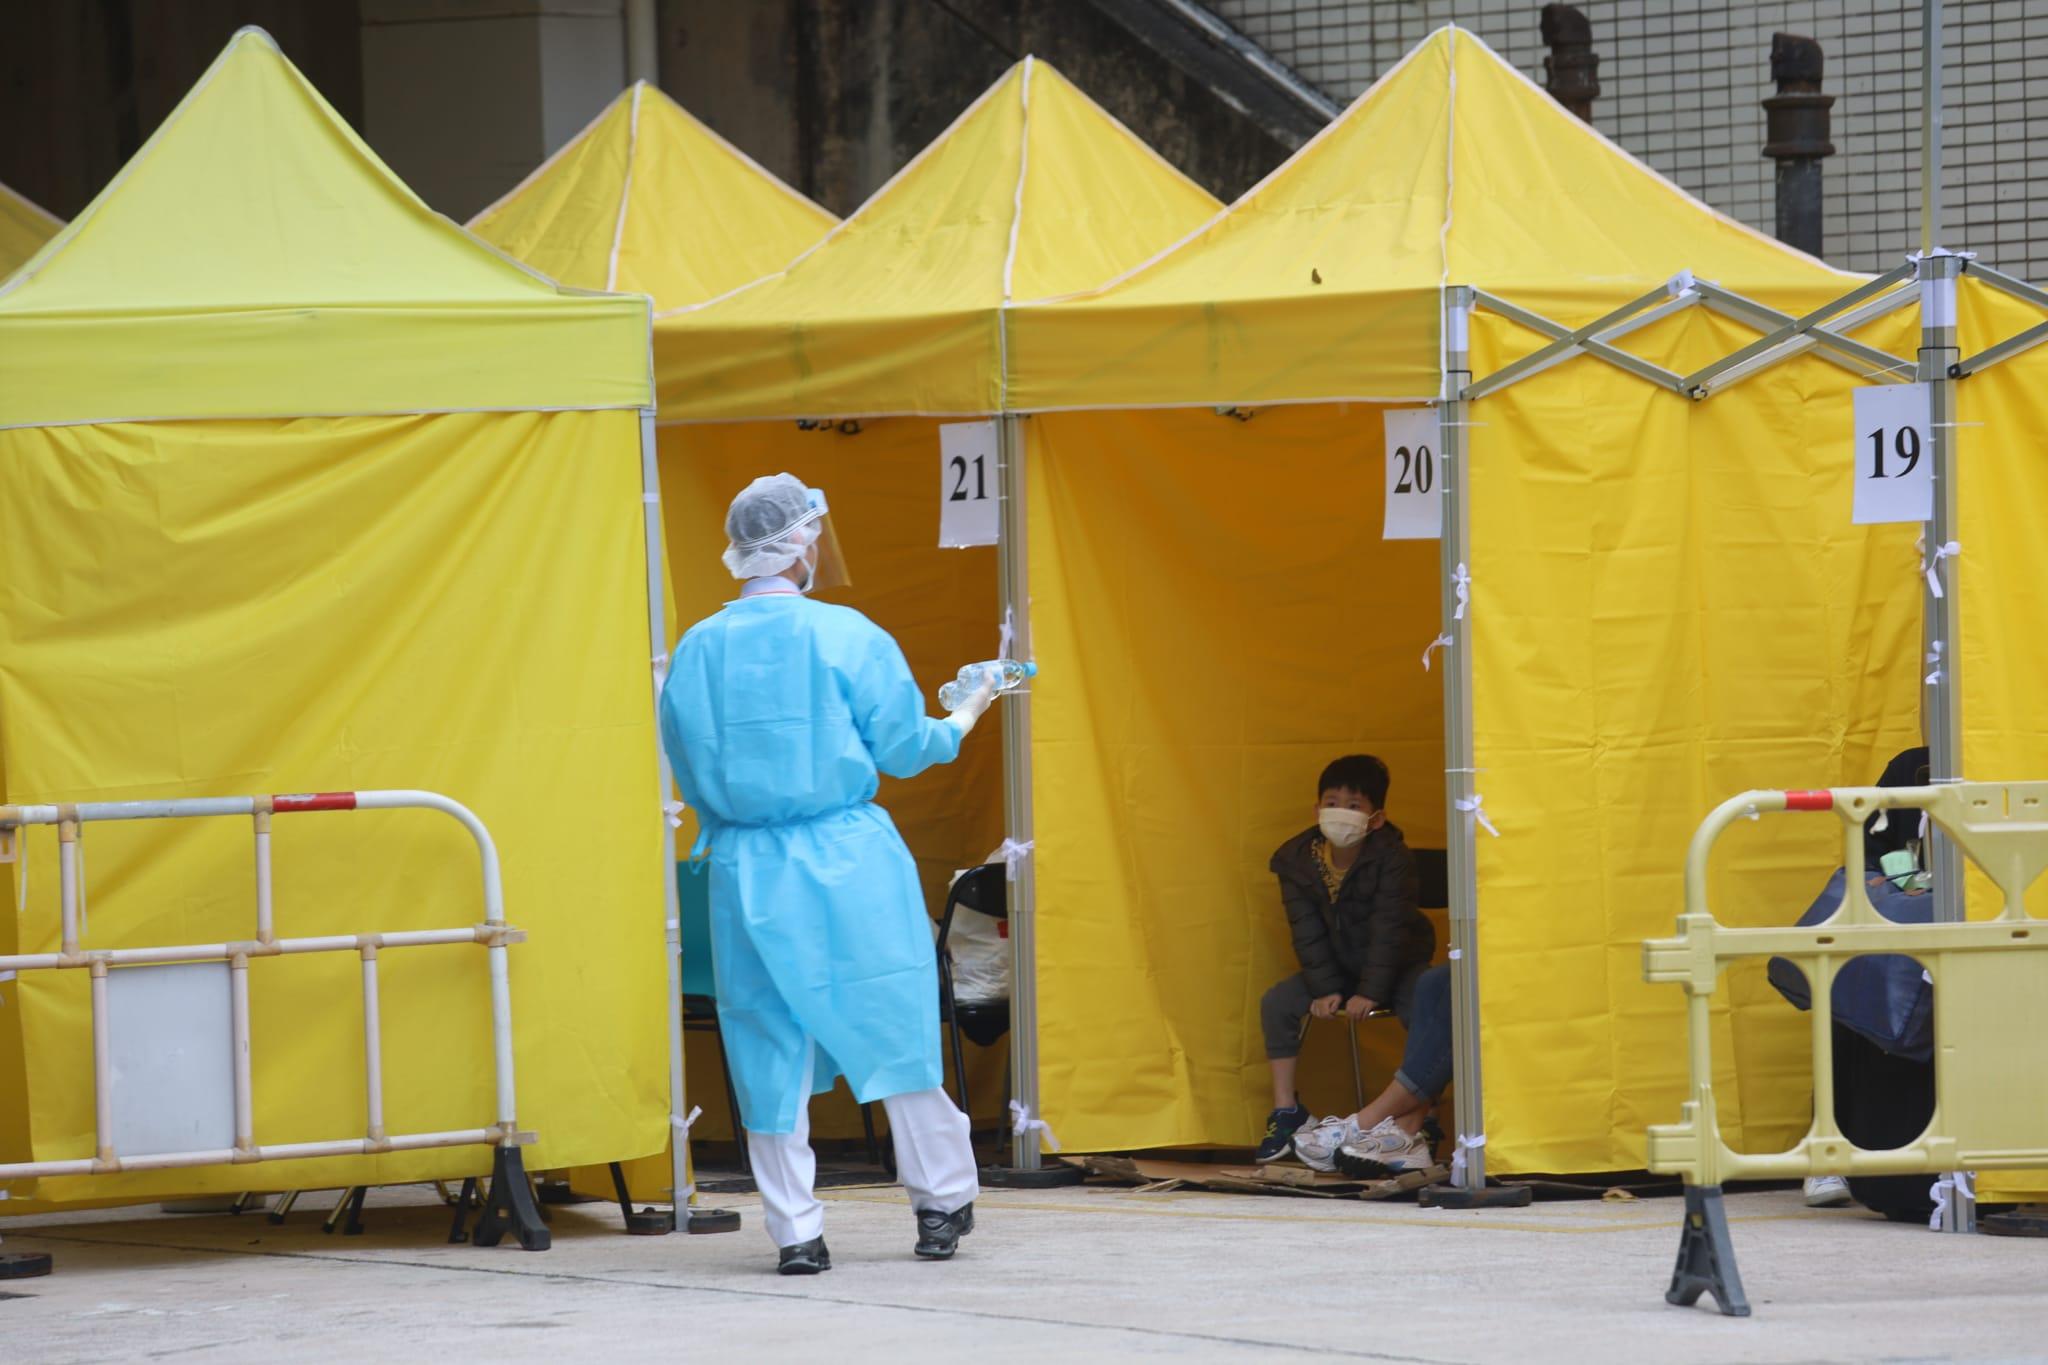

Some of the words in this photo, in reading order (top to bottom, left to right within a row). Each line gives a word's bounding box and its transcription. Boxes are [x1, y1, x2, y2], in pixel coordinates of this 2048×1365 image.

[1394, 444, 1434, 495] 20
[1868, 425, 1921, 479] 19
[949, 454, 989, 502] 21
